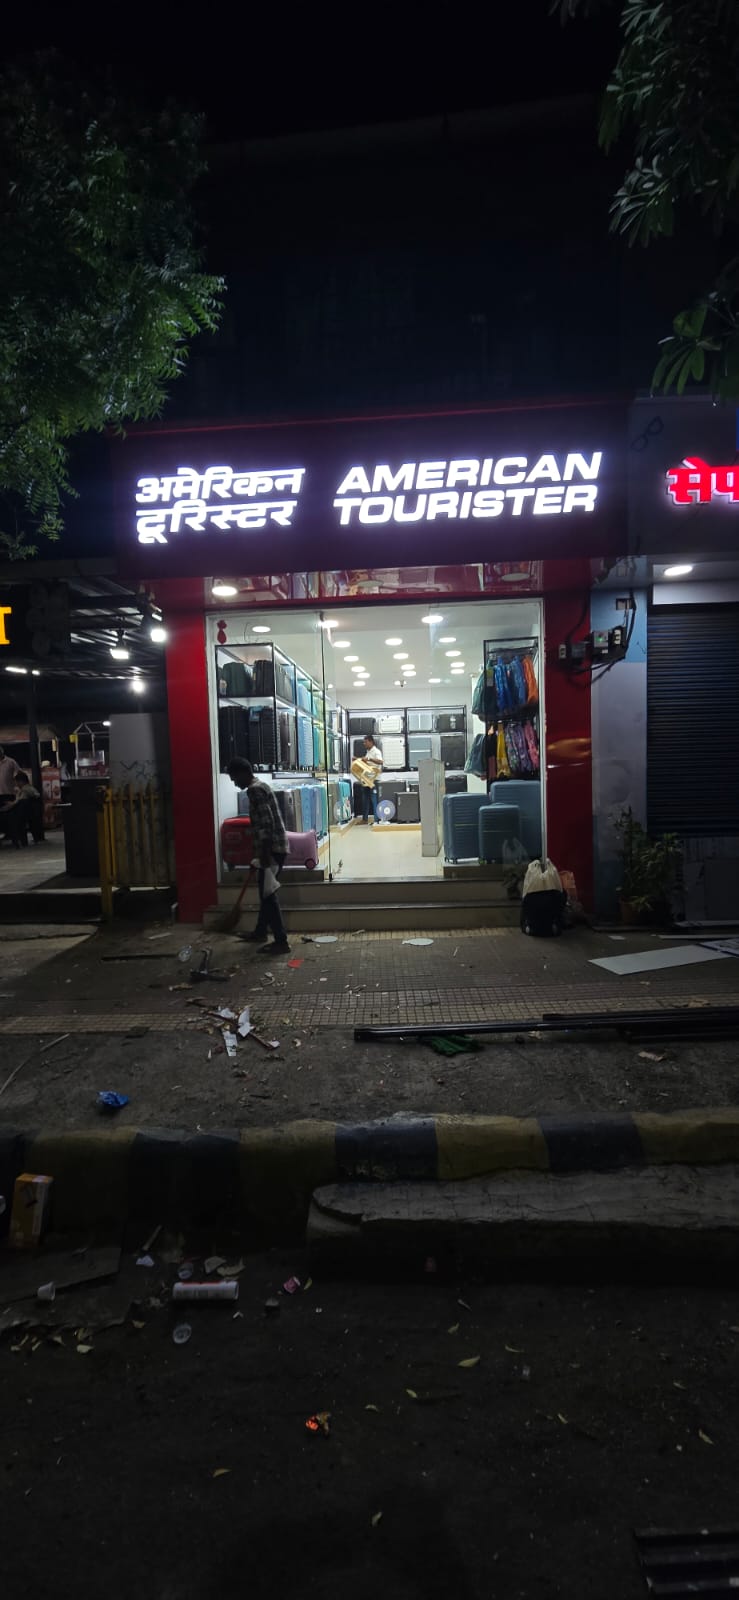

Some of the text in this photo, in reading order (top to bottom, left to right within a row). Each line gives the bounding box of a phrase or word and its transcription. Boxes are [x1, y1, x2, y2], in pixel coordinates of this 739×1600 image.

[136, 466, 305, 503] अमेरिकन
[337, 452, 602, 494] AMERICAN
[136, 500, 297, 544] टूरिस्टर
[334, 486, 598, 525] TOURISTER
